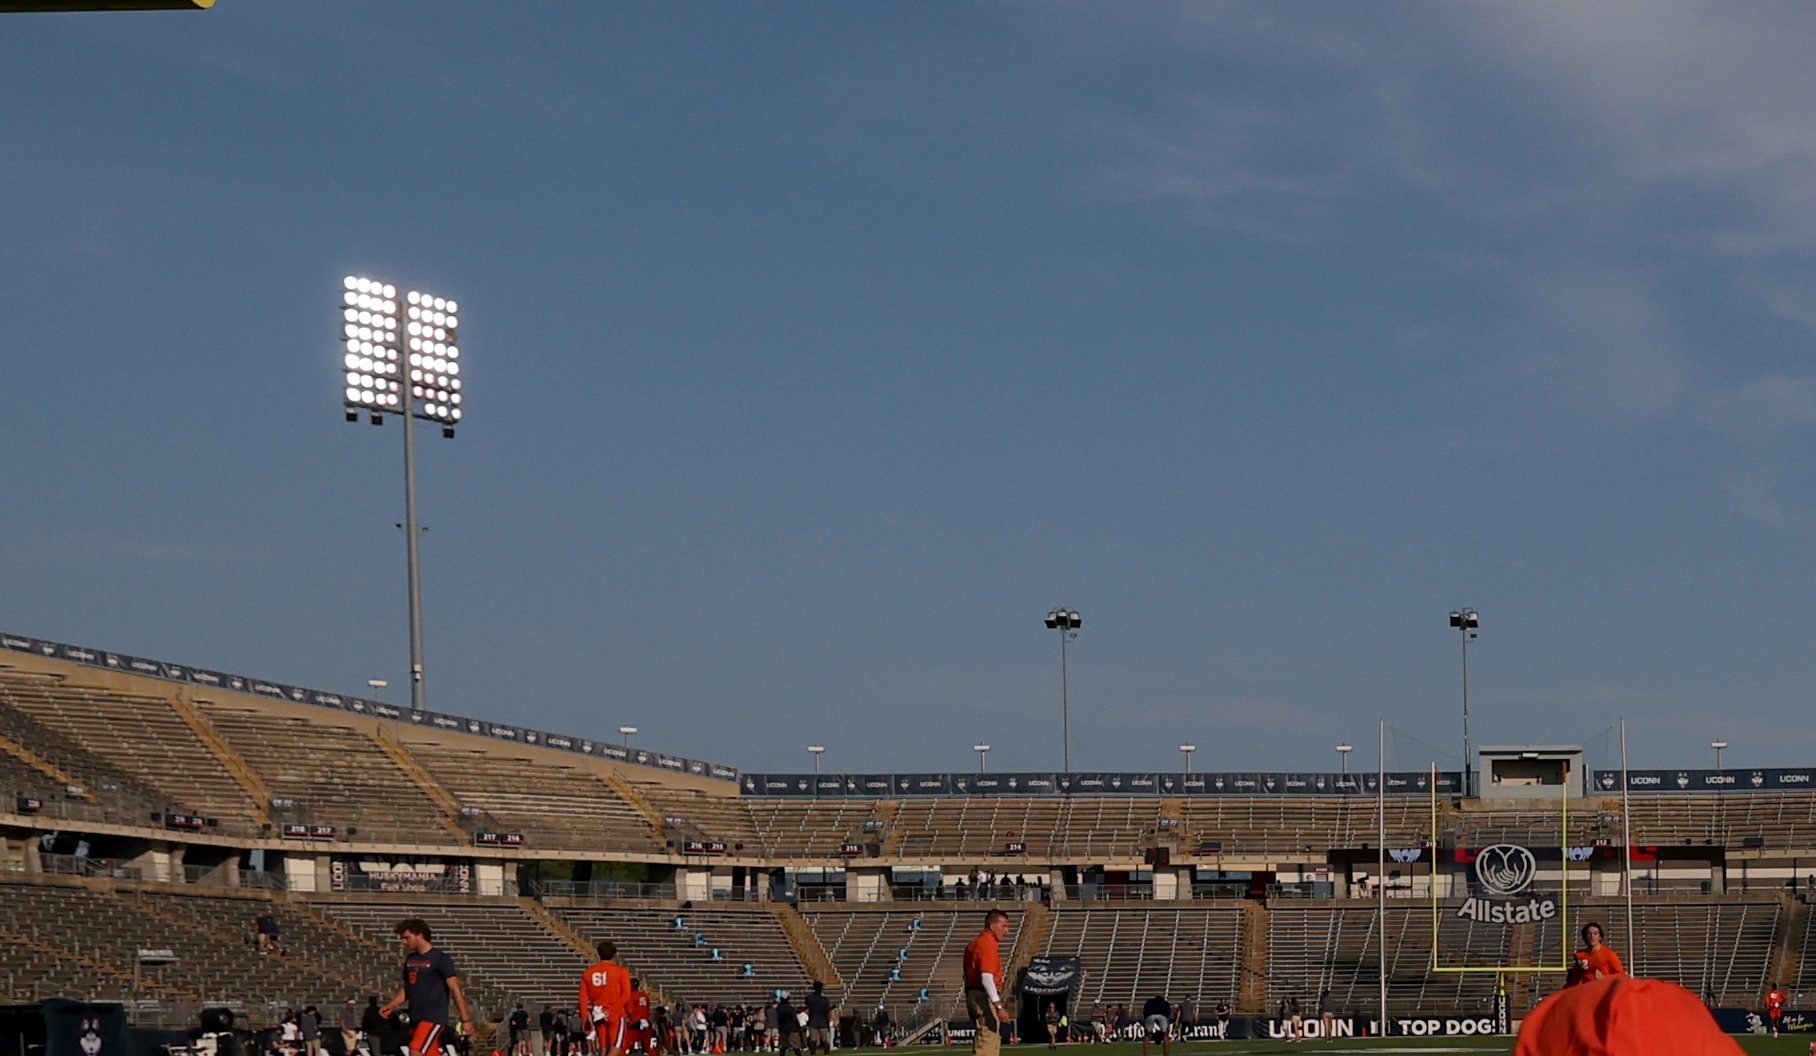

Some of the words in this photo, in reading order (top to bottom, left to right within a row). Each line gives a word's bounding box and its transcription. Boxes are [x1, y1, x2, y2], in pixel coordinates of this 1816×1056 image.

[548, 737, 571, 748] UCONN
[604, 746, 627, 758] UCONN
[658, 757, 681, 768] UCONN
[712, 768, 735, 778] UCONN
[1028, 779, 1051, 787] UCONN
[1080, 779, 1102, 787] UCONN
[1131, 779, 1153, 787] UCONN
[1386, 779, 1407, 787] UCONN
[1630, 776, 1661, 786] UCONN
[1705, 775, 1735, 785] UCONN
[1779, 774, 1810, 784] UCONN
[766, 781, 788, 789] UCONN
[818, 781, 840, 789] UCONN
[866, 781, 888, 789] UCONN
[919, 781, 941, 789] UCONN
[976, 780, 998, 788] UCONN
[1183, 780, 1205, 788] UCONN
[1234, 780, 1256, 788] UCONN
[1286, 780, 1307, 788] UCONN
[1335, 780, 1356, 788] UCONN
[1456, 897, 1556, 925] Allstate
[591, 971, 607, 987] 61
[1023, 984, 1070, 994] UCONN
[1498, 996, 1507, 1035] UCONN
[1397, 1019, 1441, 1036] TOP
